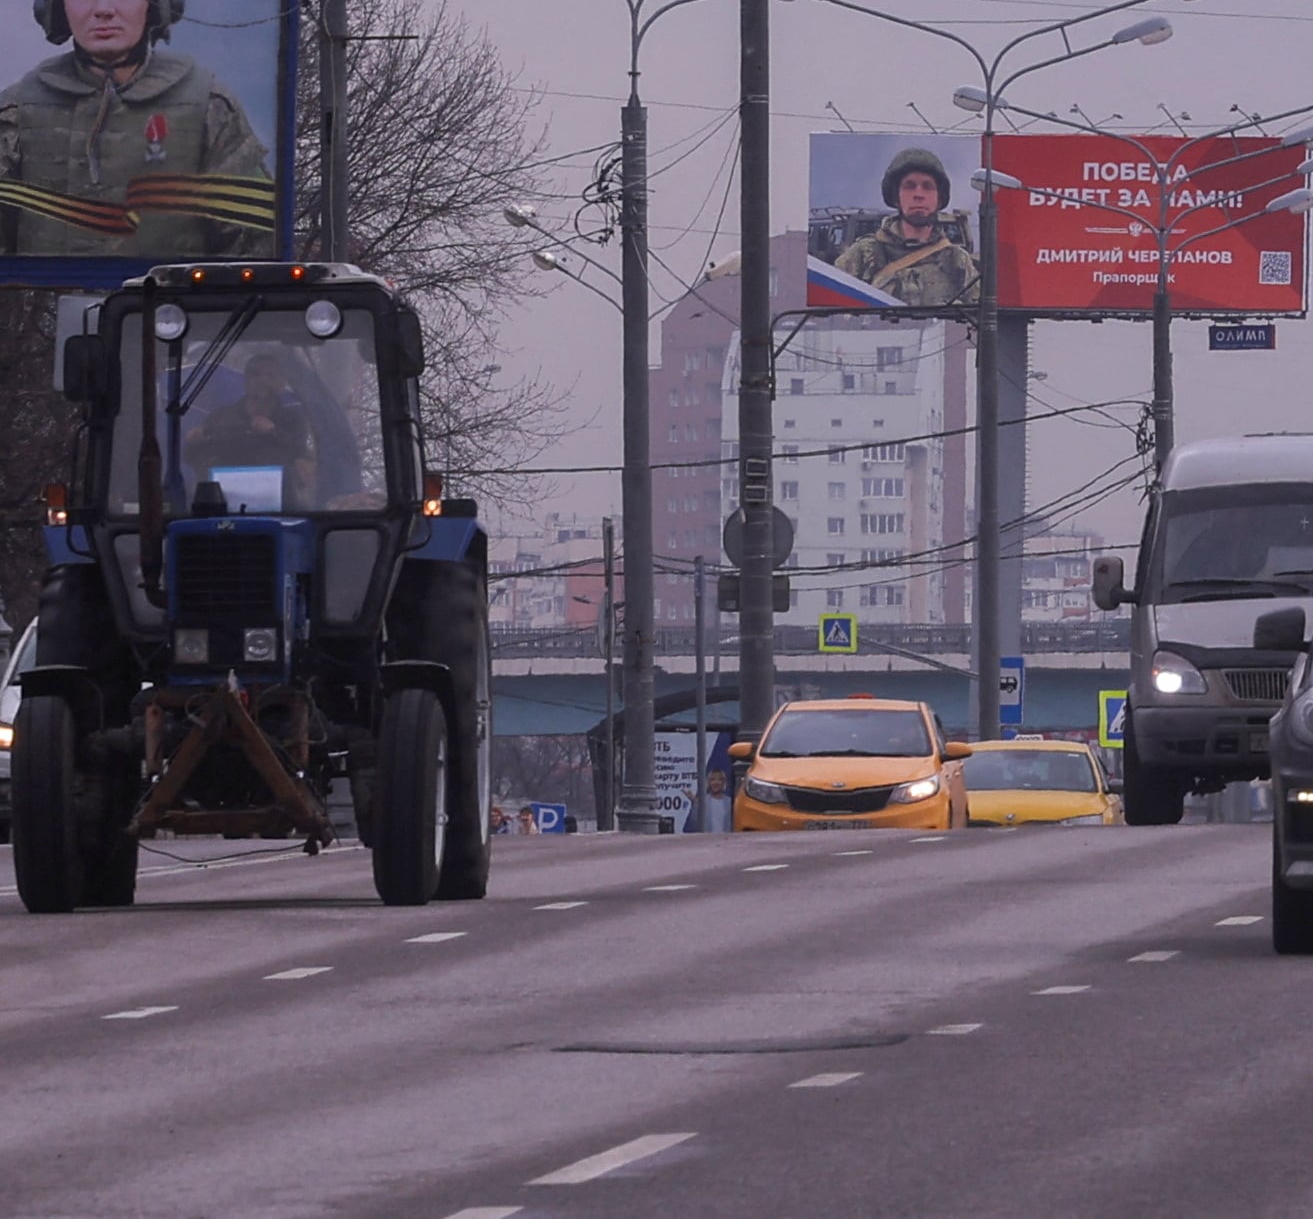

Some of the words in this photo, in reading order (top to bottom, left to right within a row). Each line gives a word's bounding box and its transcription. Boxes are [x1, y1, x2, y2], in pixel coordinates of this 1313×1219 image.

[1083, 162, 1190, 184] ПОБЕДА
[1029, 187, 1110, 209] БУДЕТ
[1118, 189, 1151, 207] ЗА
[1036, 247, 1123, 264] ДМИТРИЙ
[1128, 250, 1232, 264] ЧЕРЕПАНОВ
[1093, 271, 1175, 284] Прапорщк
[1216, 330, 1266, 341] ОЛИМП
[655, 783, 692, 792] лучите
